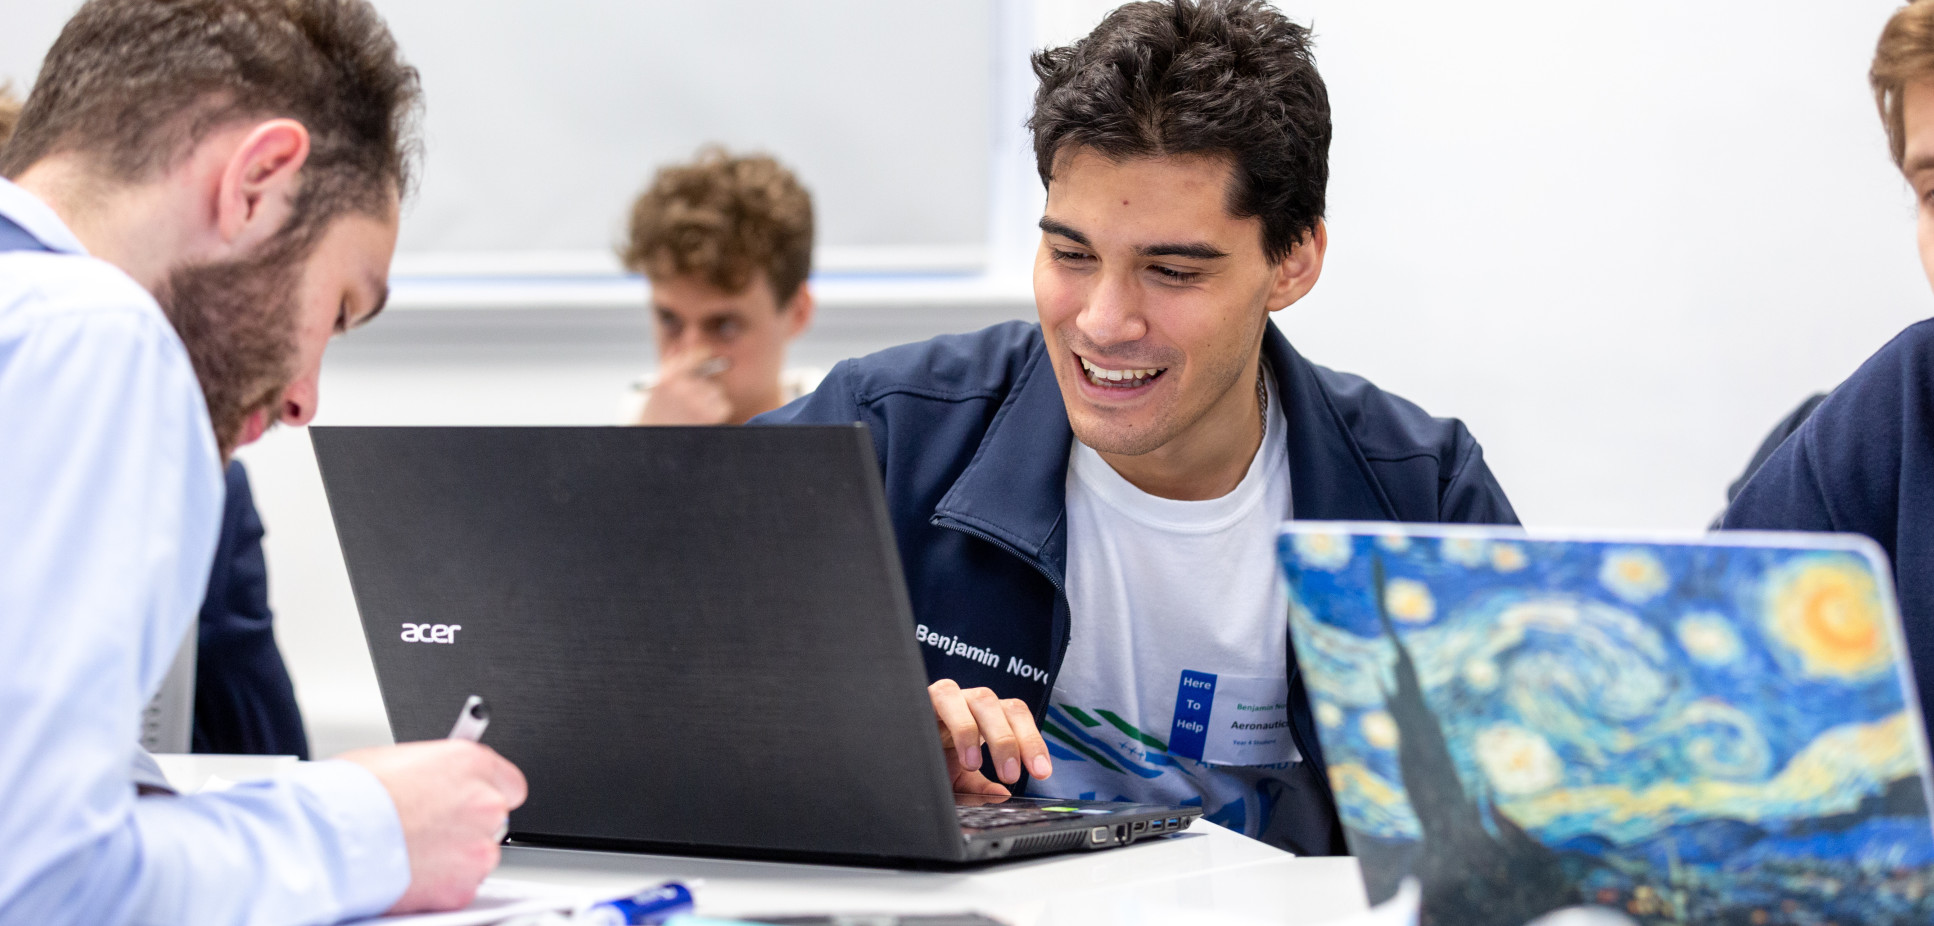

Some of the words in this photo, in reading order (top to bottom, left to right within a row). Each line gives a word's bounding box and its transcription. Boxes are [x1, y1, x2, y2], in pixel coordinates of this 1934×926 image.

[400, 622, 462, 644] acer
[915, 623, 1000, 668] Benjamin
[1183, 677, 1212, 690] Here
[1187, 699, 1201, 711] To
[1237, 703, 1274, 712] Benjamin
[1275, 703, 1287, 711] No
[1177, 719, 1204, 733] Help
